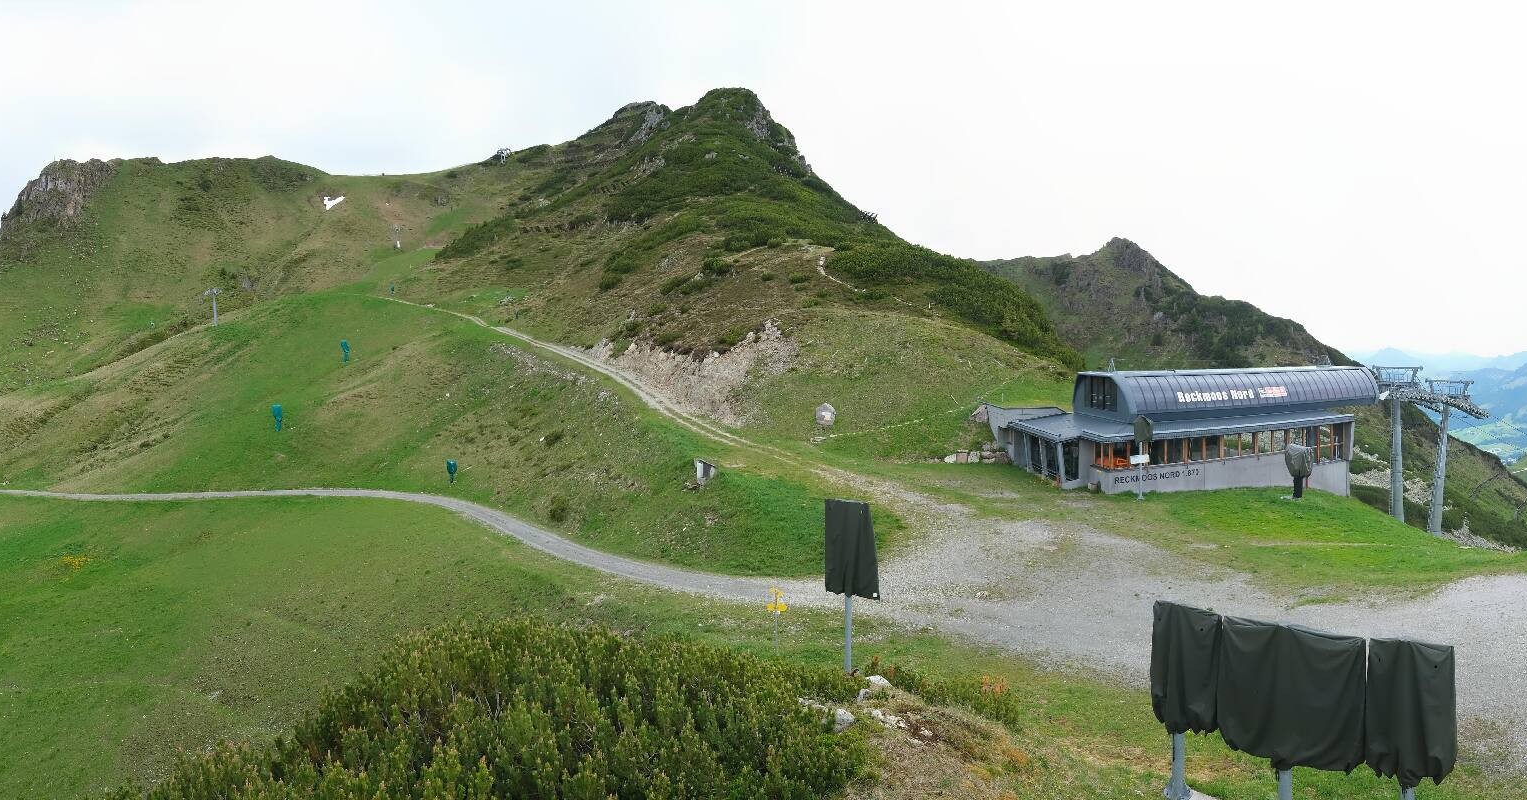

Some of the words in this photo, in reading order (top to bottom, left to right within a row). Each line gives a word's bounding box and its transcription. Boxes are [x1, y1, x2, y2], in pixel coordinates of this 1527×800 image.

[1177, 391, 1228, 402] Reckmoos
[1230, 389, 1254, 400] Nord
[1159, 470, 1180, 480] NORD
